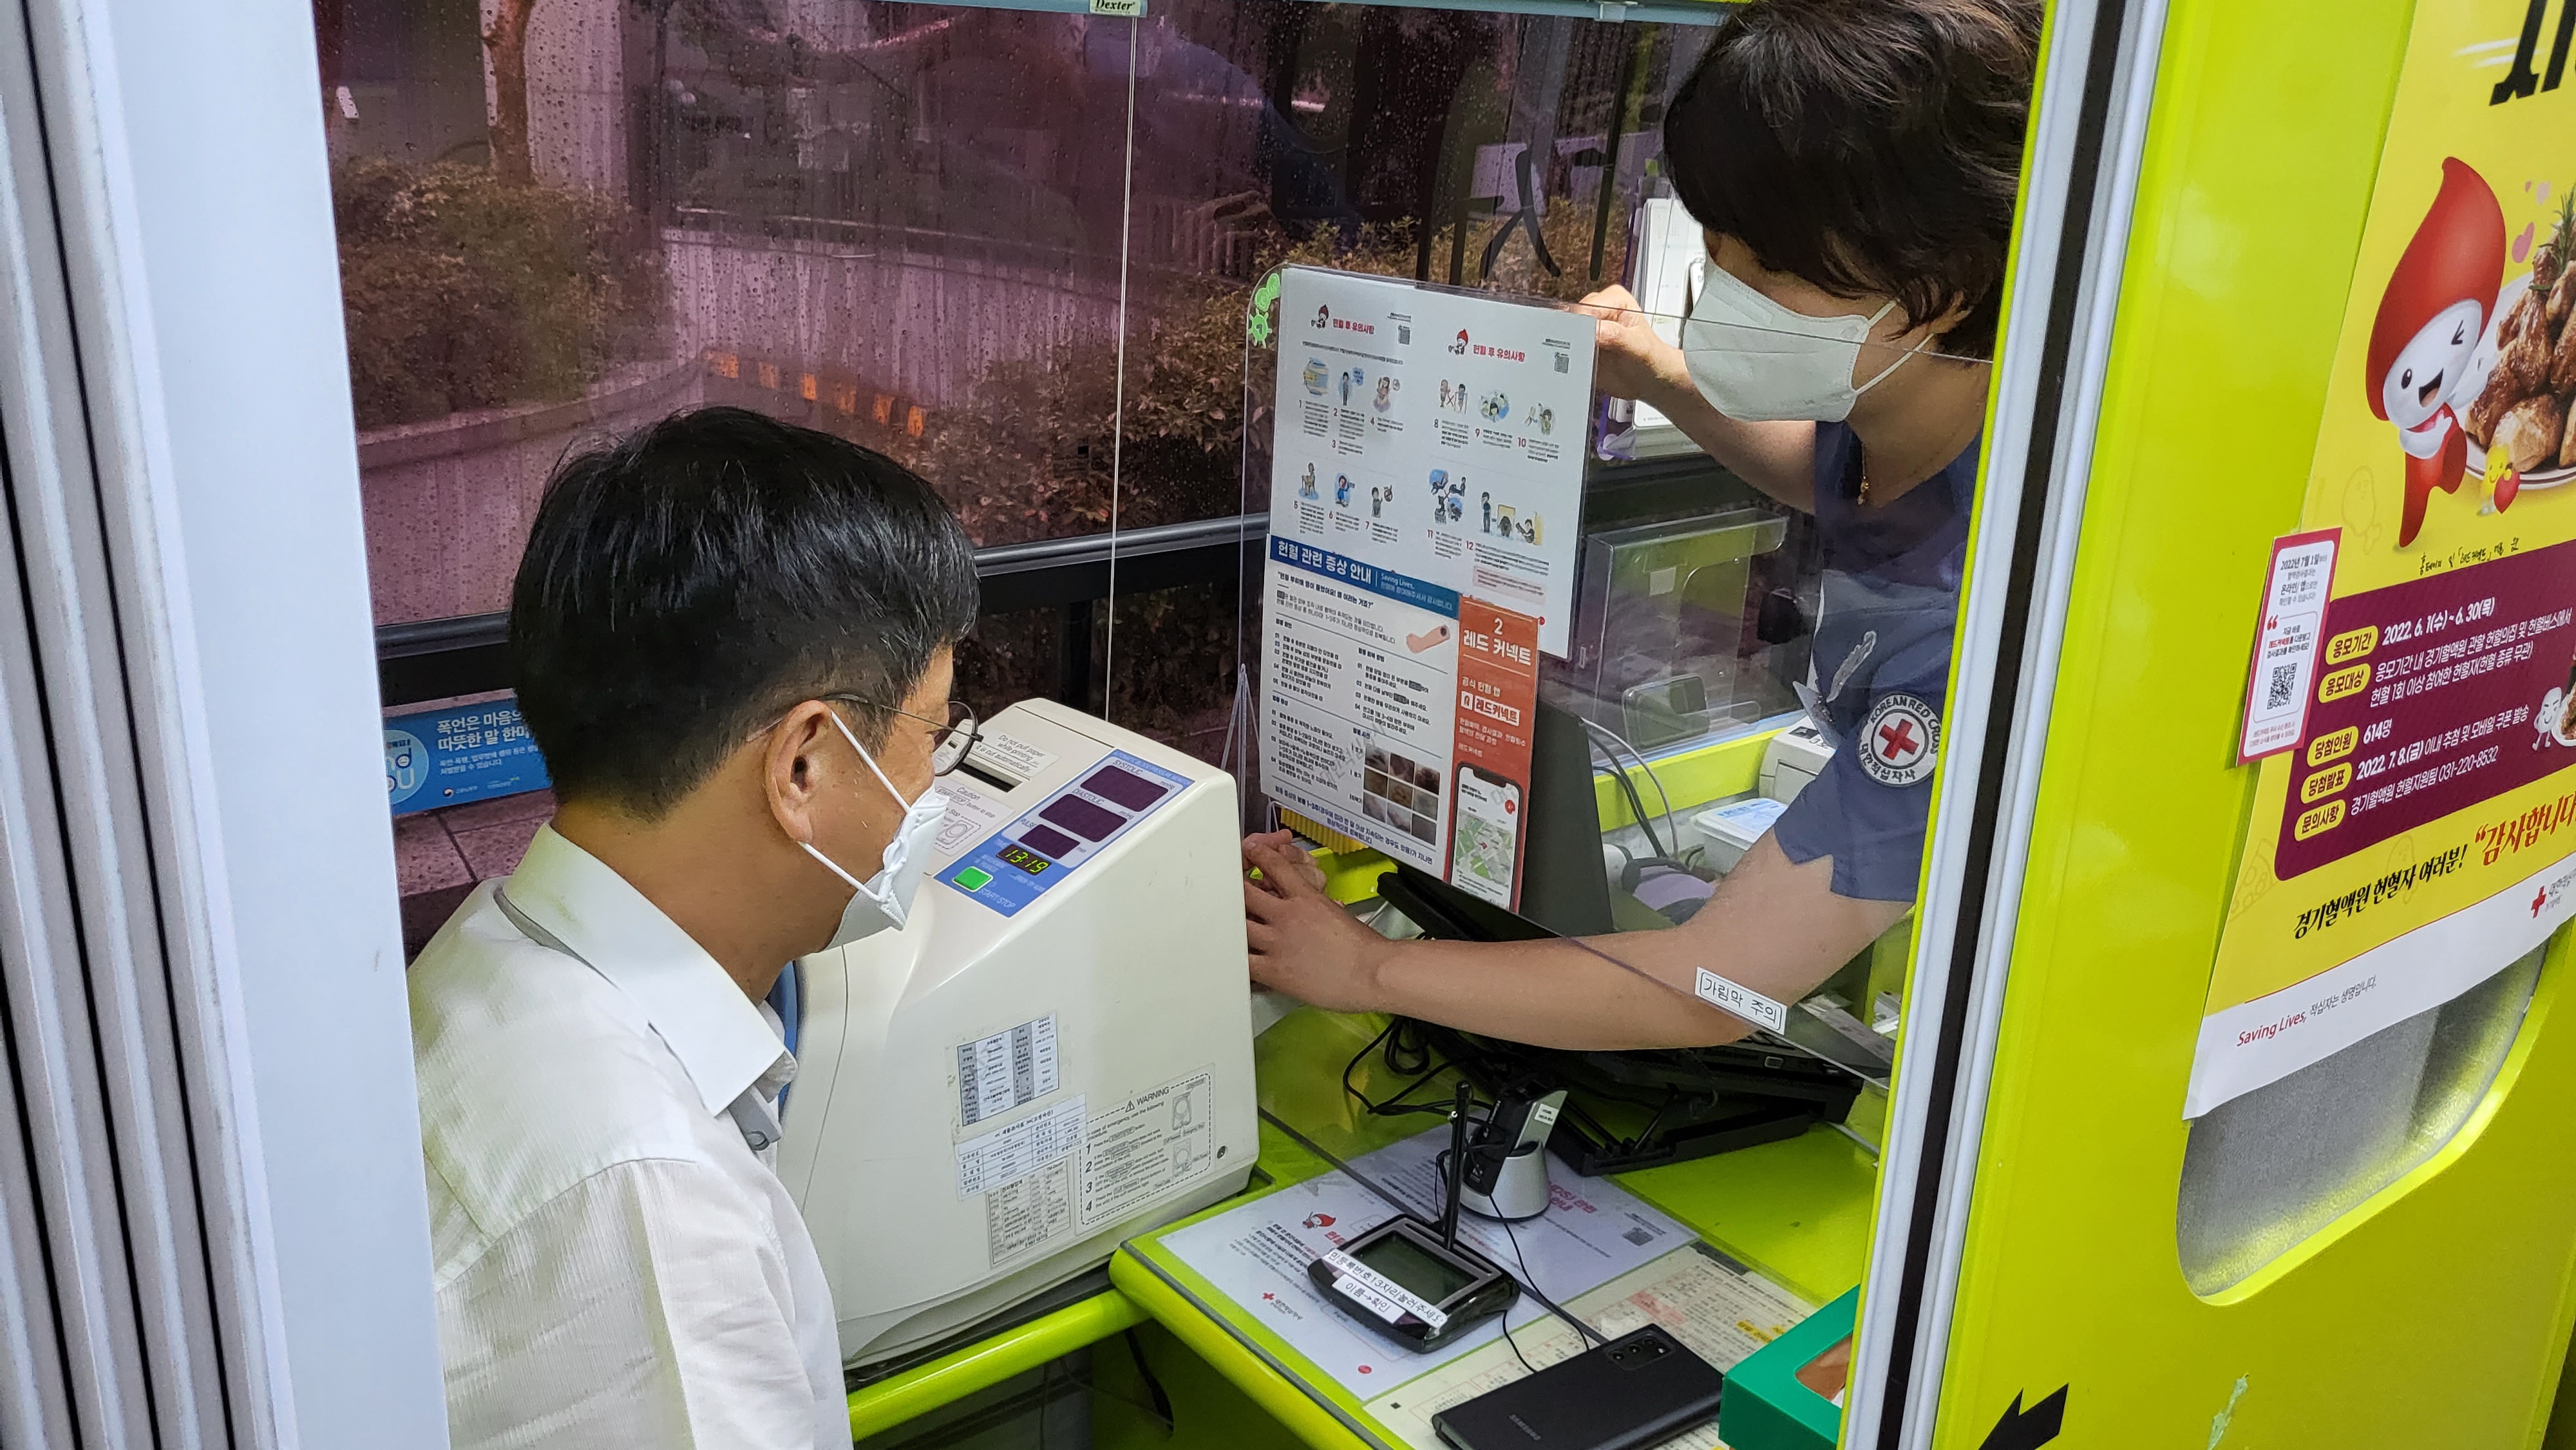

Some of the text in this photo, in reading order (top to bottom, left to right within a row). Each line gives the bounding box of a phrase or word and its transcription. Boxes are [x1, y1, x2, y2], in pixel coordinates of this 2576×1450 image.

[1096, 0, 1132, 10] Dexter
[1473, 344, 1526, 362] 헌혈 후 유의사항
[1278, 540, 1372, 585] 헌혈 관련 증상 안내
[2280, 556, 2300, 570] 2022년
[2300, 555, 2310, 567] 7월
[1381, 572, 1415, 590] Saving Lives,
[1494, 617, 1503, 636] 2
[2332, 631, 2372, 659] 응모기간
[2382, 619, 2412, 646] 2022.
[2414, 619, 2423, 637] 6.
[2425, 610, 2448, 635] 1(수)
[2455, 606, 2464, 625] 6.
[2465, 596, 2496, 621] 30(목)
[1463, 629, 1531, 666] 레드 커넥트
[2325, 607, 2573, 697] 응모대상 응모기간 내 경기혈액원 관할 헌혈의집 및 헌혈버스에서
[2370, 688, 2391, 708] 헌혈
[2392, 680, 2407, 702] 1회
[2407, 675, 2425, 697] 이상
[2425, 666, 2453, 692] 참여한
[2496, 648, 2514, 669] 종류
[2514, 641, 2534, 663] 무관)
[1476, 698, 1518, 724] 레드커넥트
[437, 715, 482, 735] 폭언은
[1870, 696, 1941, 755] KOREAN RED CROSS
[438, 725, 530, 752] 따뜻한 말 한마
[998, 742, 1012, 753] while
[1009, 739, 1017, 747] not
[1016, 741, 1028, 751] pull
[1027, 747, 1046, 758] paper
[2314, 730, 2353, 760] 당첨인원
[2363, 718, 2393, 745] 614명
[985, 748, 996, 757] cut
[994, 753, 1031, 773] automatically.
[2308, 704, 2530, 797] 당첨발표 2022. 7. 8.(금) 이내 추첨 및 모바일 쿠폰 발송
[1113, 759, 1143, 775] SYSTOLIC
[1860, 741, 1916, 783] 대한적십자사
[956, 787, 981, 801] Caution
[1160, 780, 1176, 790] mmHg
[2302, 745, 2499, 834] 문의사항 경기혈액원 헌혈지원팀 031-220-8532
[1072, 788, 1105, 805] DIASTOLIC
[1019, 818, 1037, 829] PULSE
[1005, 849, 1049, 873] 13:19
[978, 887, 1016, 909] START/STOP
[2293, 882, 2372, 940] 경기혈액원
[2373, 863, 2418, 905] 헌혈자
[2419, 843, 2468, 883] 여러분!
[1703, 977, 1777, 1024] 가림막 주의
[2309, 974, 2376, 1017] 적십자는 생명입니다.
[2237, 1011, 2307, 1047] Saving Lives,
[1137, 1086, 1170, 1106] WARNING
[1086, 1143, 1091, 1155] 1
[1085, 1161, 1092, 1174] 2
[1086, 1182, 1093, 1194] 3
[1086, 1200, 1092, 1212] 4
